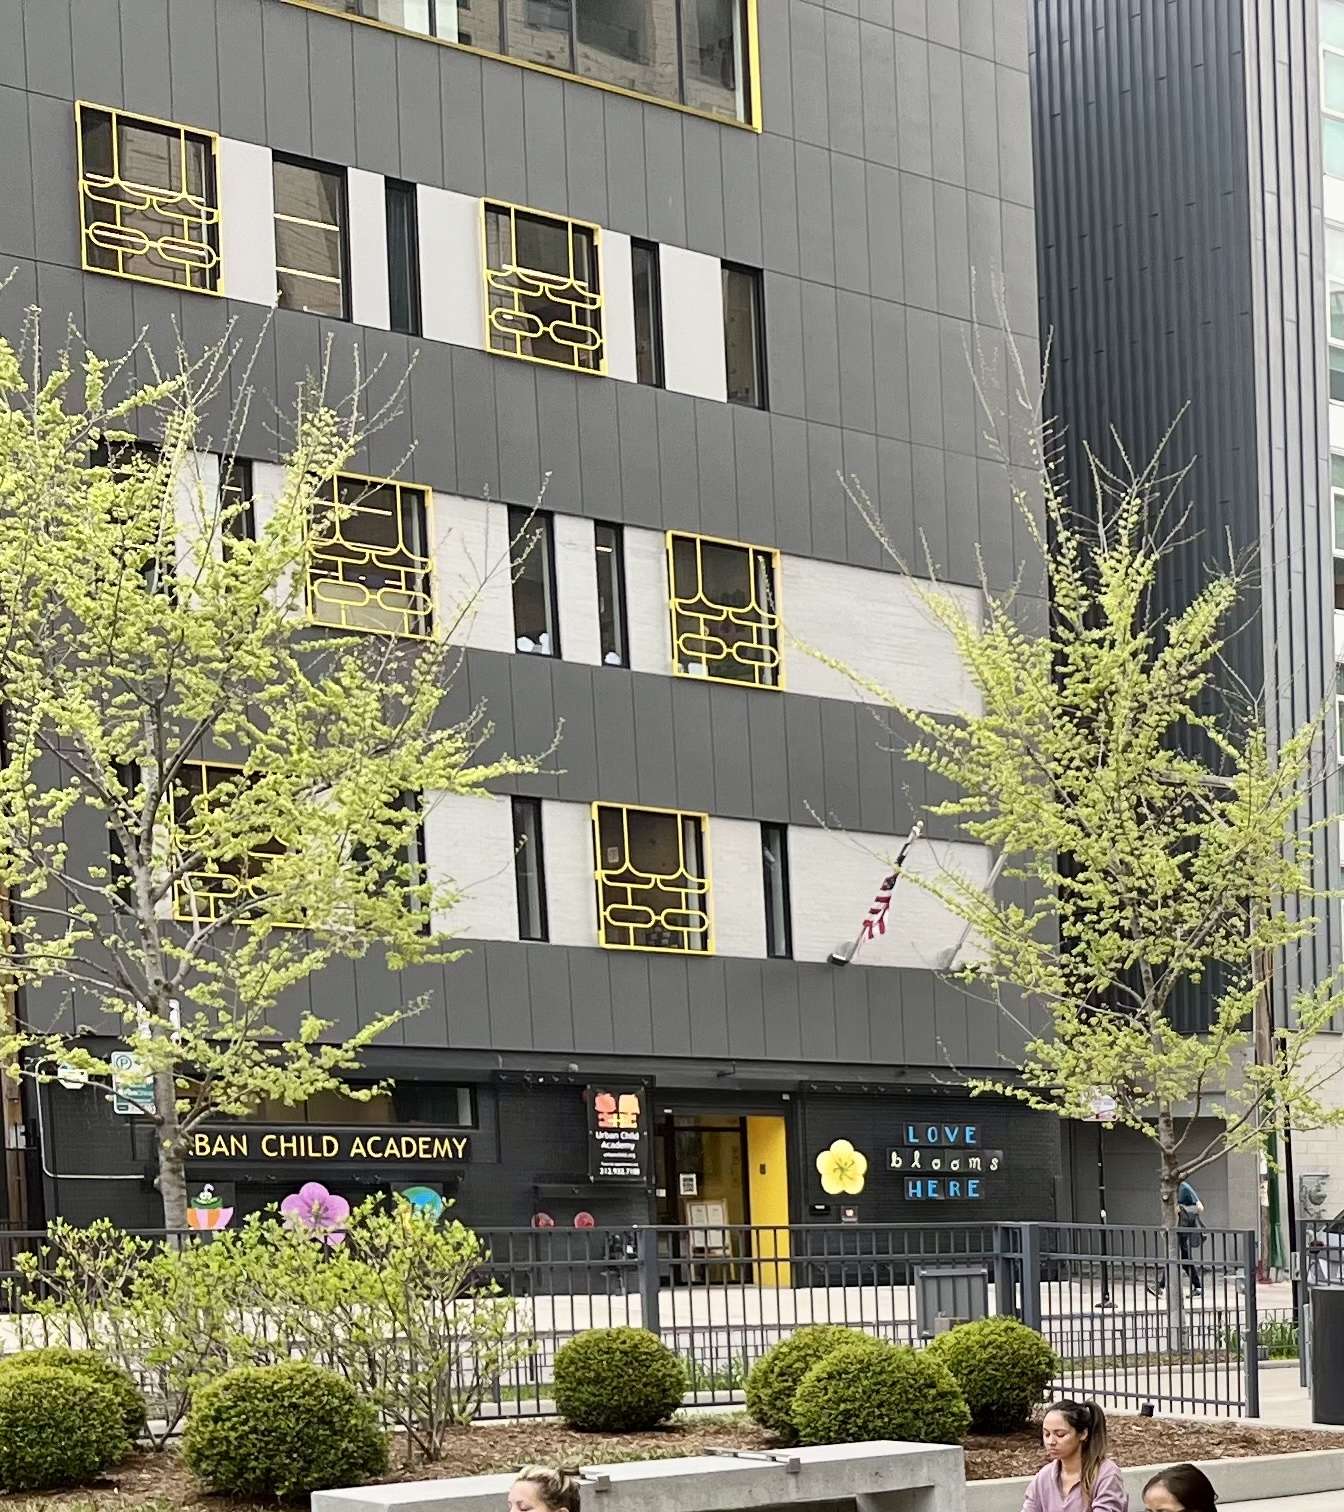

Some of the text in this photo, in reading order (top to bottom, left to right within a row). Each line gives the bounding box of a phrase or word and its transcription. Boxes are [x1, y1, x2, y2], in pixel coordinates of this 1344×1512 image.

[907, 1126, 977, 1144] LOVE
[189, 1133, 468, 1159] BAN CHILD ACADEMY
[889, 1150, 999, 1172] blooms
[908, 1178, 980, 1198] HERE
